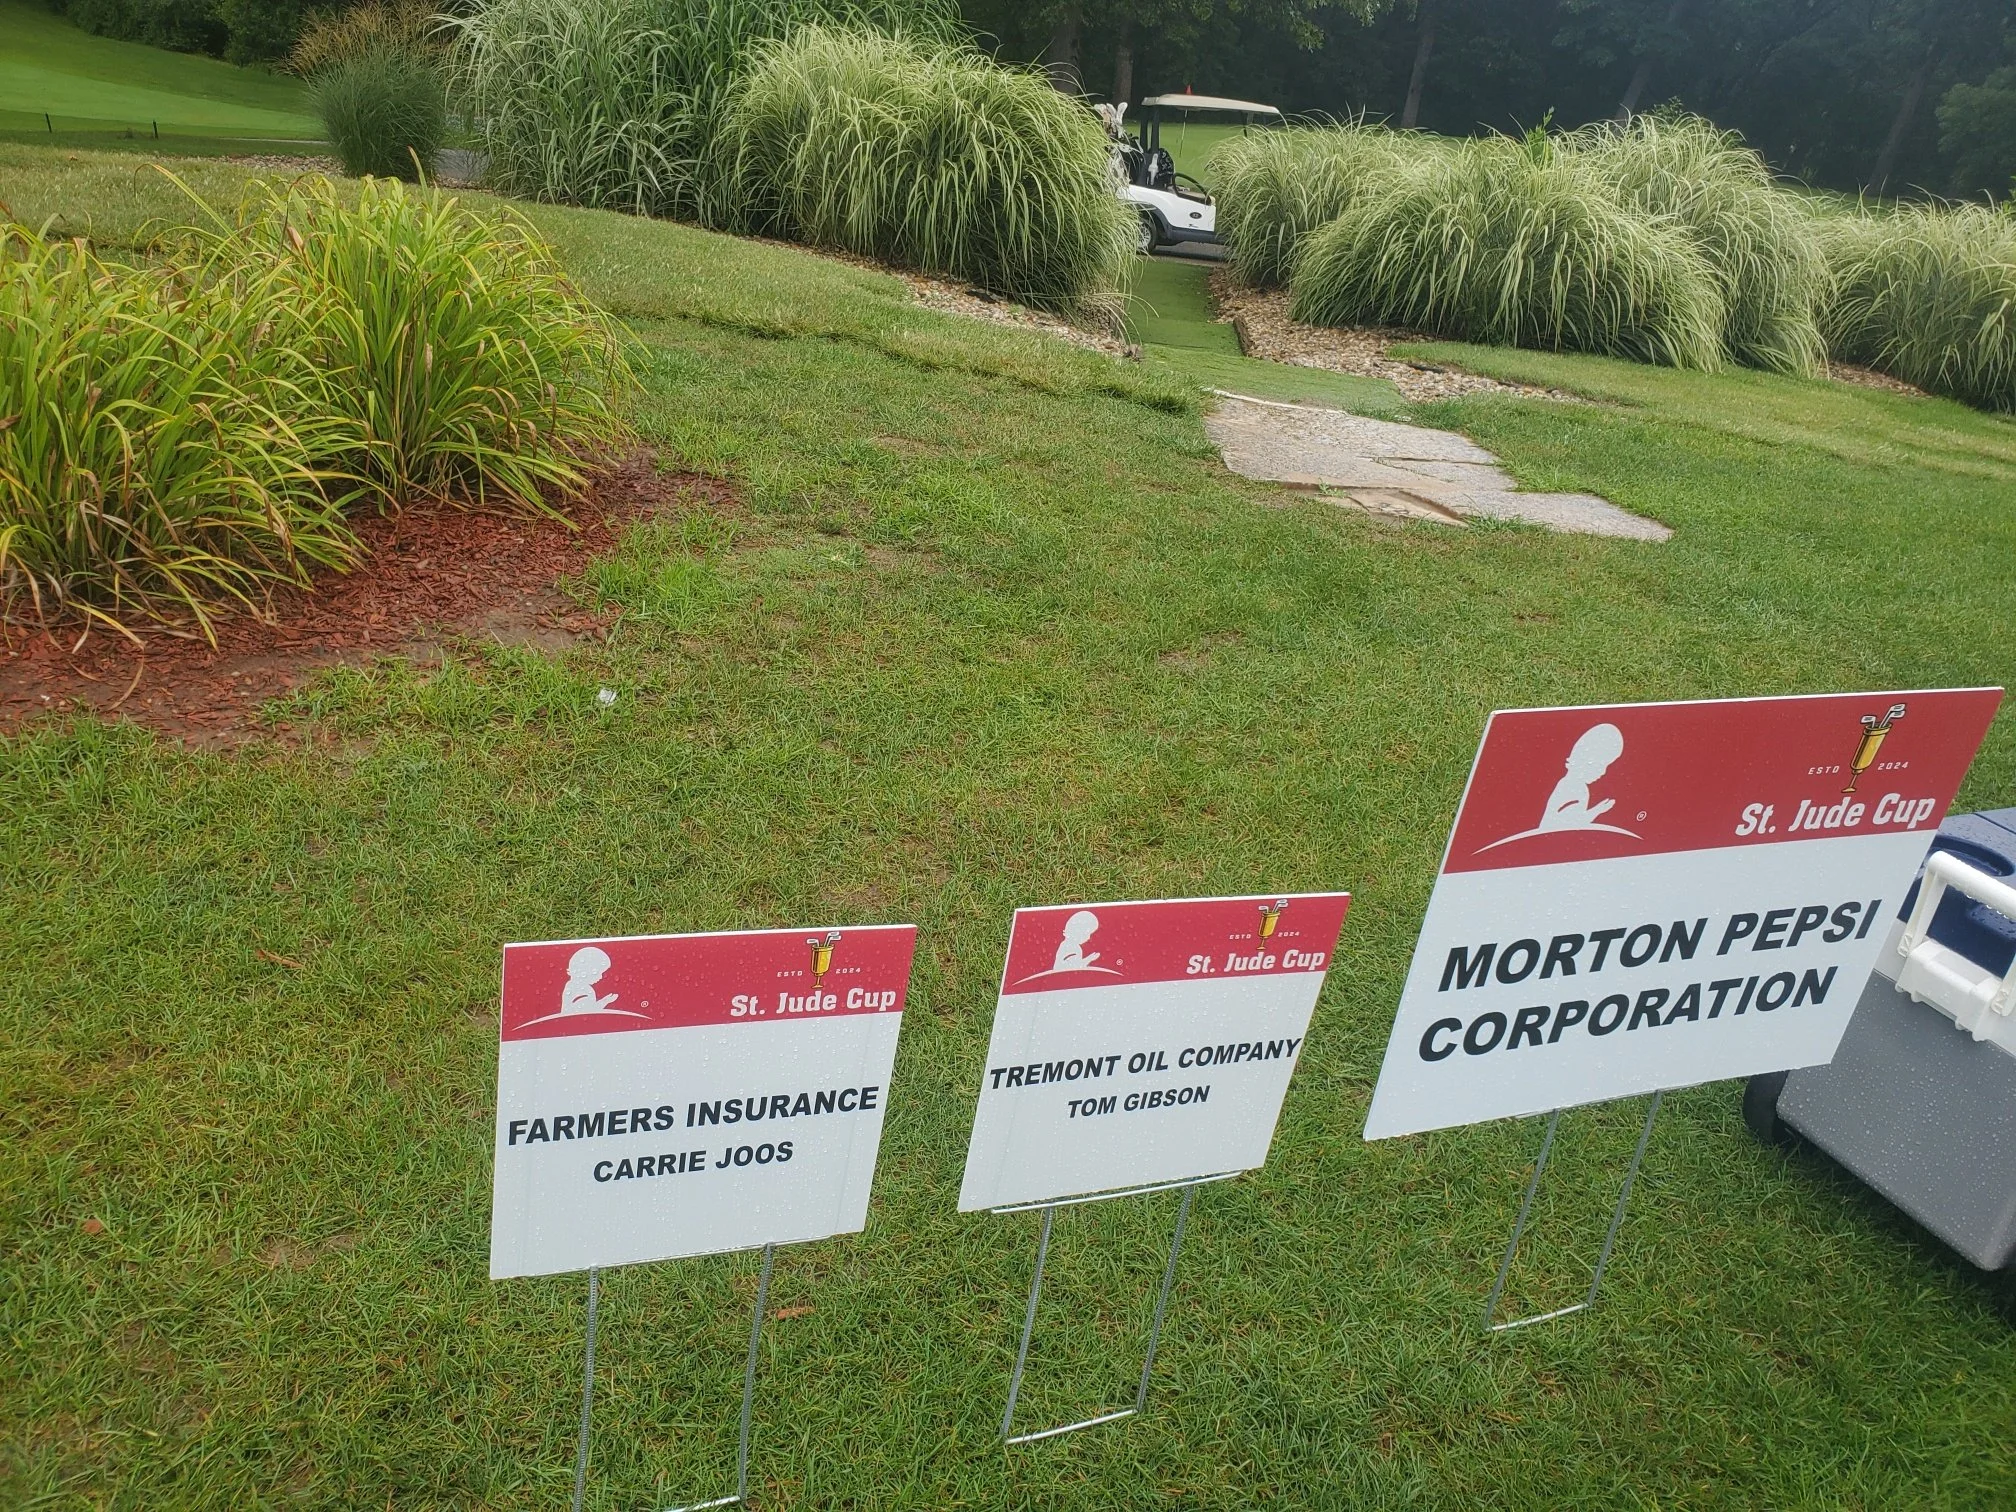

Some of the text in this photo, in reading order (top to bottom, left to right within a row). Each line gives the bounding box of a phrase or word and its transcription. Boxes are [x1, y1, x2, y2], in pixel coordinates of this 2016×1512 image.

[1808, 761, 1909, 775] ESTD 2024
[1735, 793, 1936, 836] St. Jude Cup
[1186, 949, 1325, 974] St. Jude Cup
[1438, 899, 1882, 992] MORTON PEPSI
[777, 970, 803, 978] ESTD
[730, 988, 896, 1016] St. Jude Cup
[1418, 966, 1838, 1062] CORPORATION
[990, 1038, 1302, 1089] TREMONT OIL COMPANY
[508, 1086, 880, 1146] FARMERS INSURANCE
[1068, 1086, 1211, 1118] TOM GIBSON
[593, 1141, 794, 1182] CARRIE JOOS
